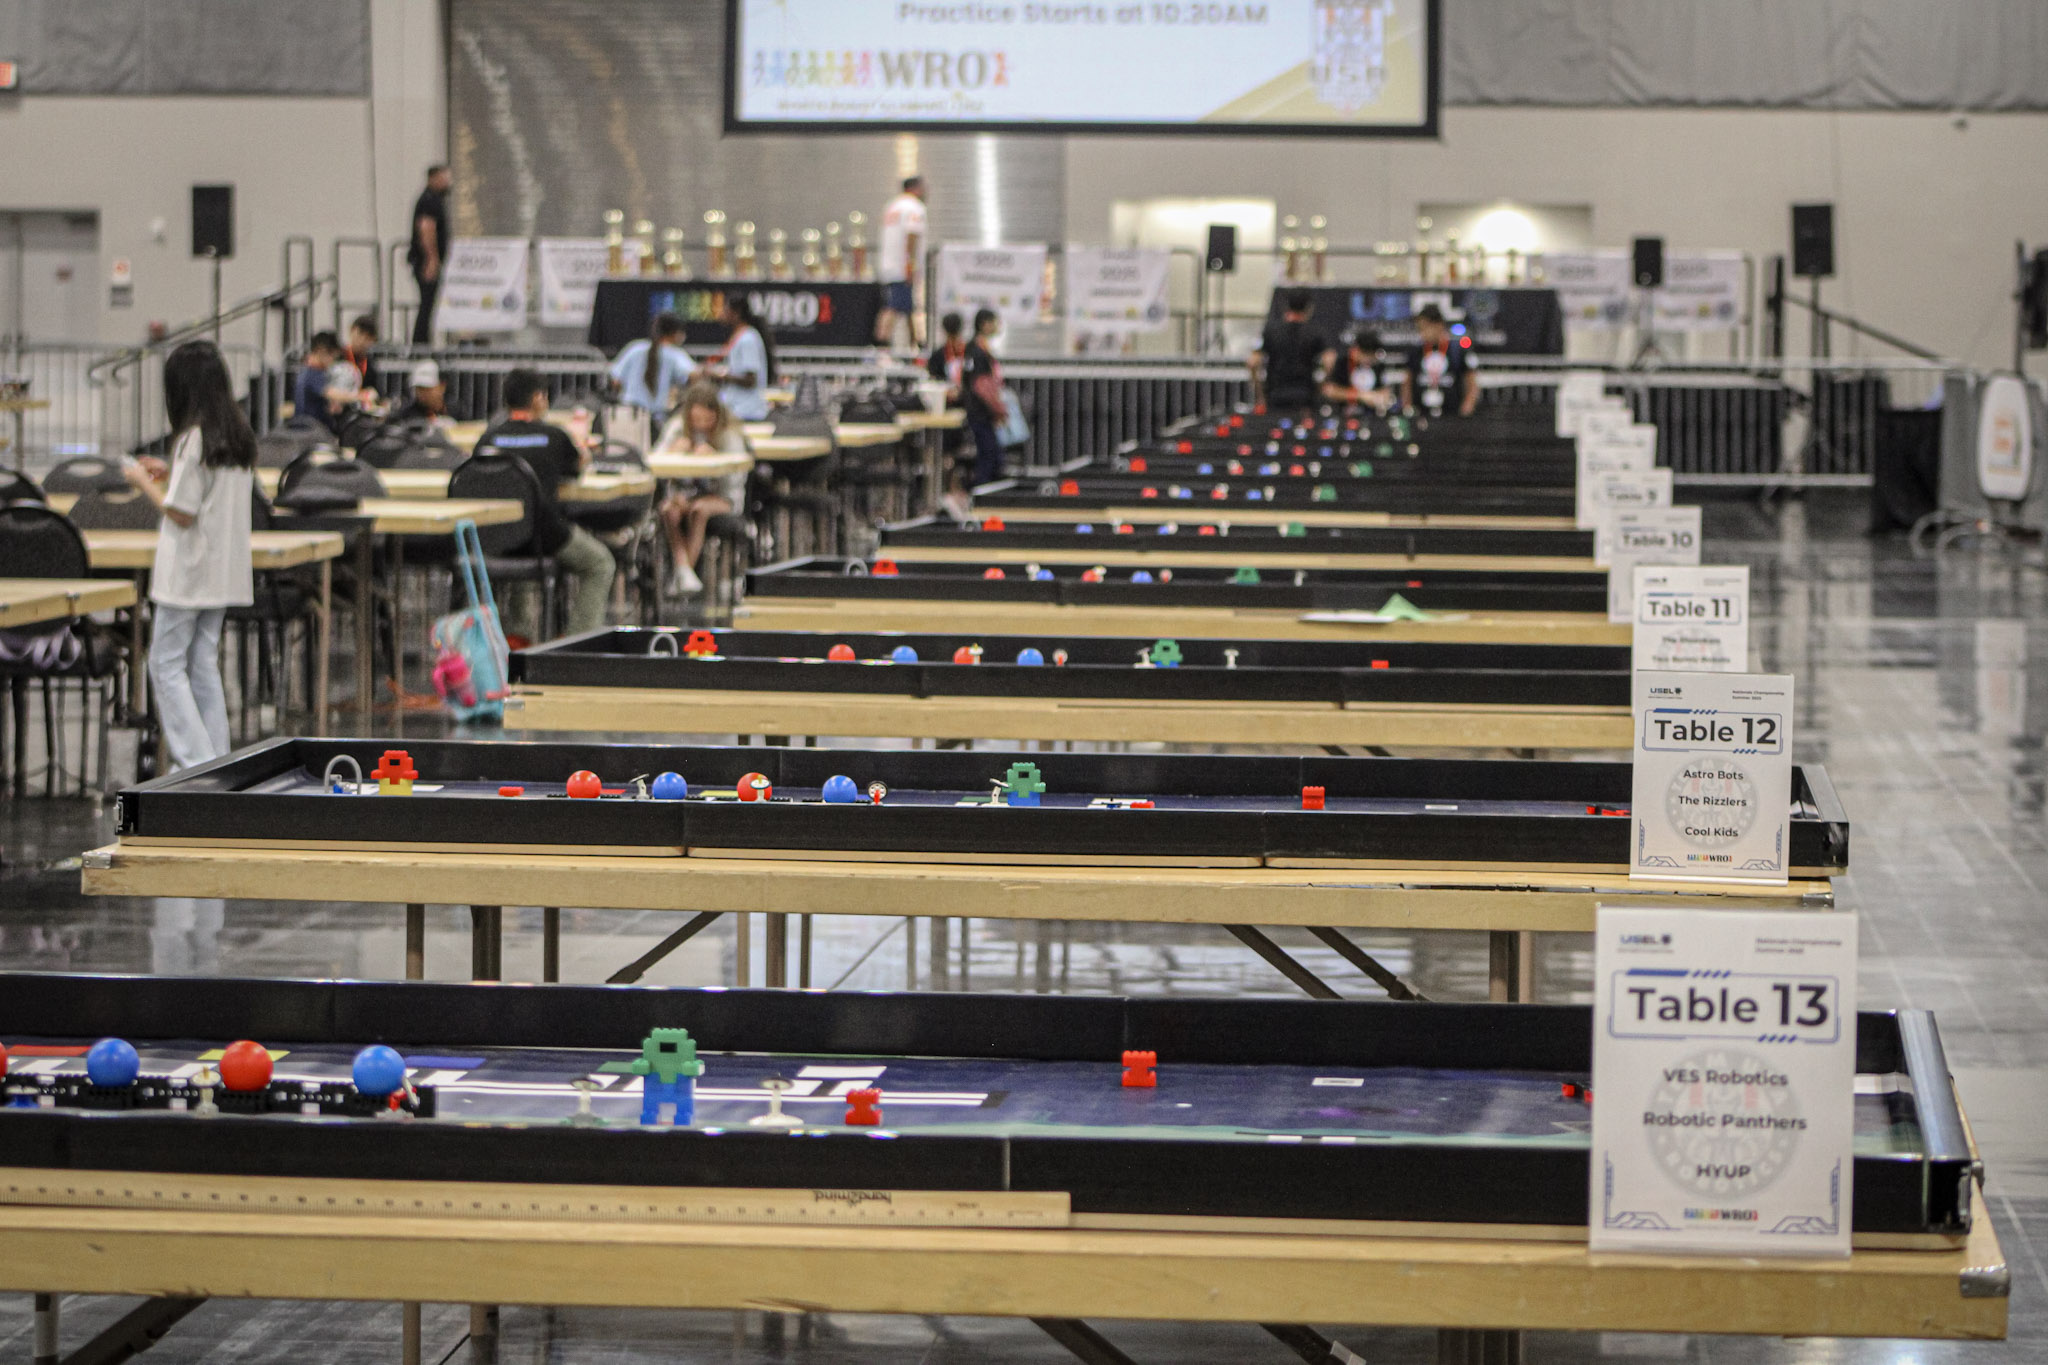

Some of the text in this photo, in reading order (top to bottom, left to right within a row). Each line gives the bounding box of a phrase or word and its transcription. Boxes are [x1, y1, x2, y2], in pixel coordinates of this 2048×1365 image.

[899, 3, 1016, 23] Practice
[1024, 3, 1106, 23] Starts
[1115, 4, 1143, 23] at
[1622, 531, 1693, 548] Table 10
[1648, 598, 1731, 618] Table 11
[1650, 687, 1674, 695] USEL
[1654, 717, 1777, 745] Table 12
[1683, 769, 1744, 781] Astro Bots
[1678, 796, 1747, 808] The Rizzlers
[1685, 826, 1739, 838] Cool Kids
[1628, 983, 1829, 1027] Table 13
[1663, 1069, 1789, 1086] VES Robotics
[1643, 1112, 1808, 1130] Robotic Panthers
[1697, 1165, 1752, 1179] HYUP
